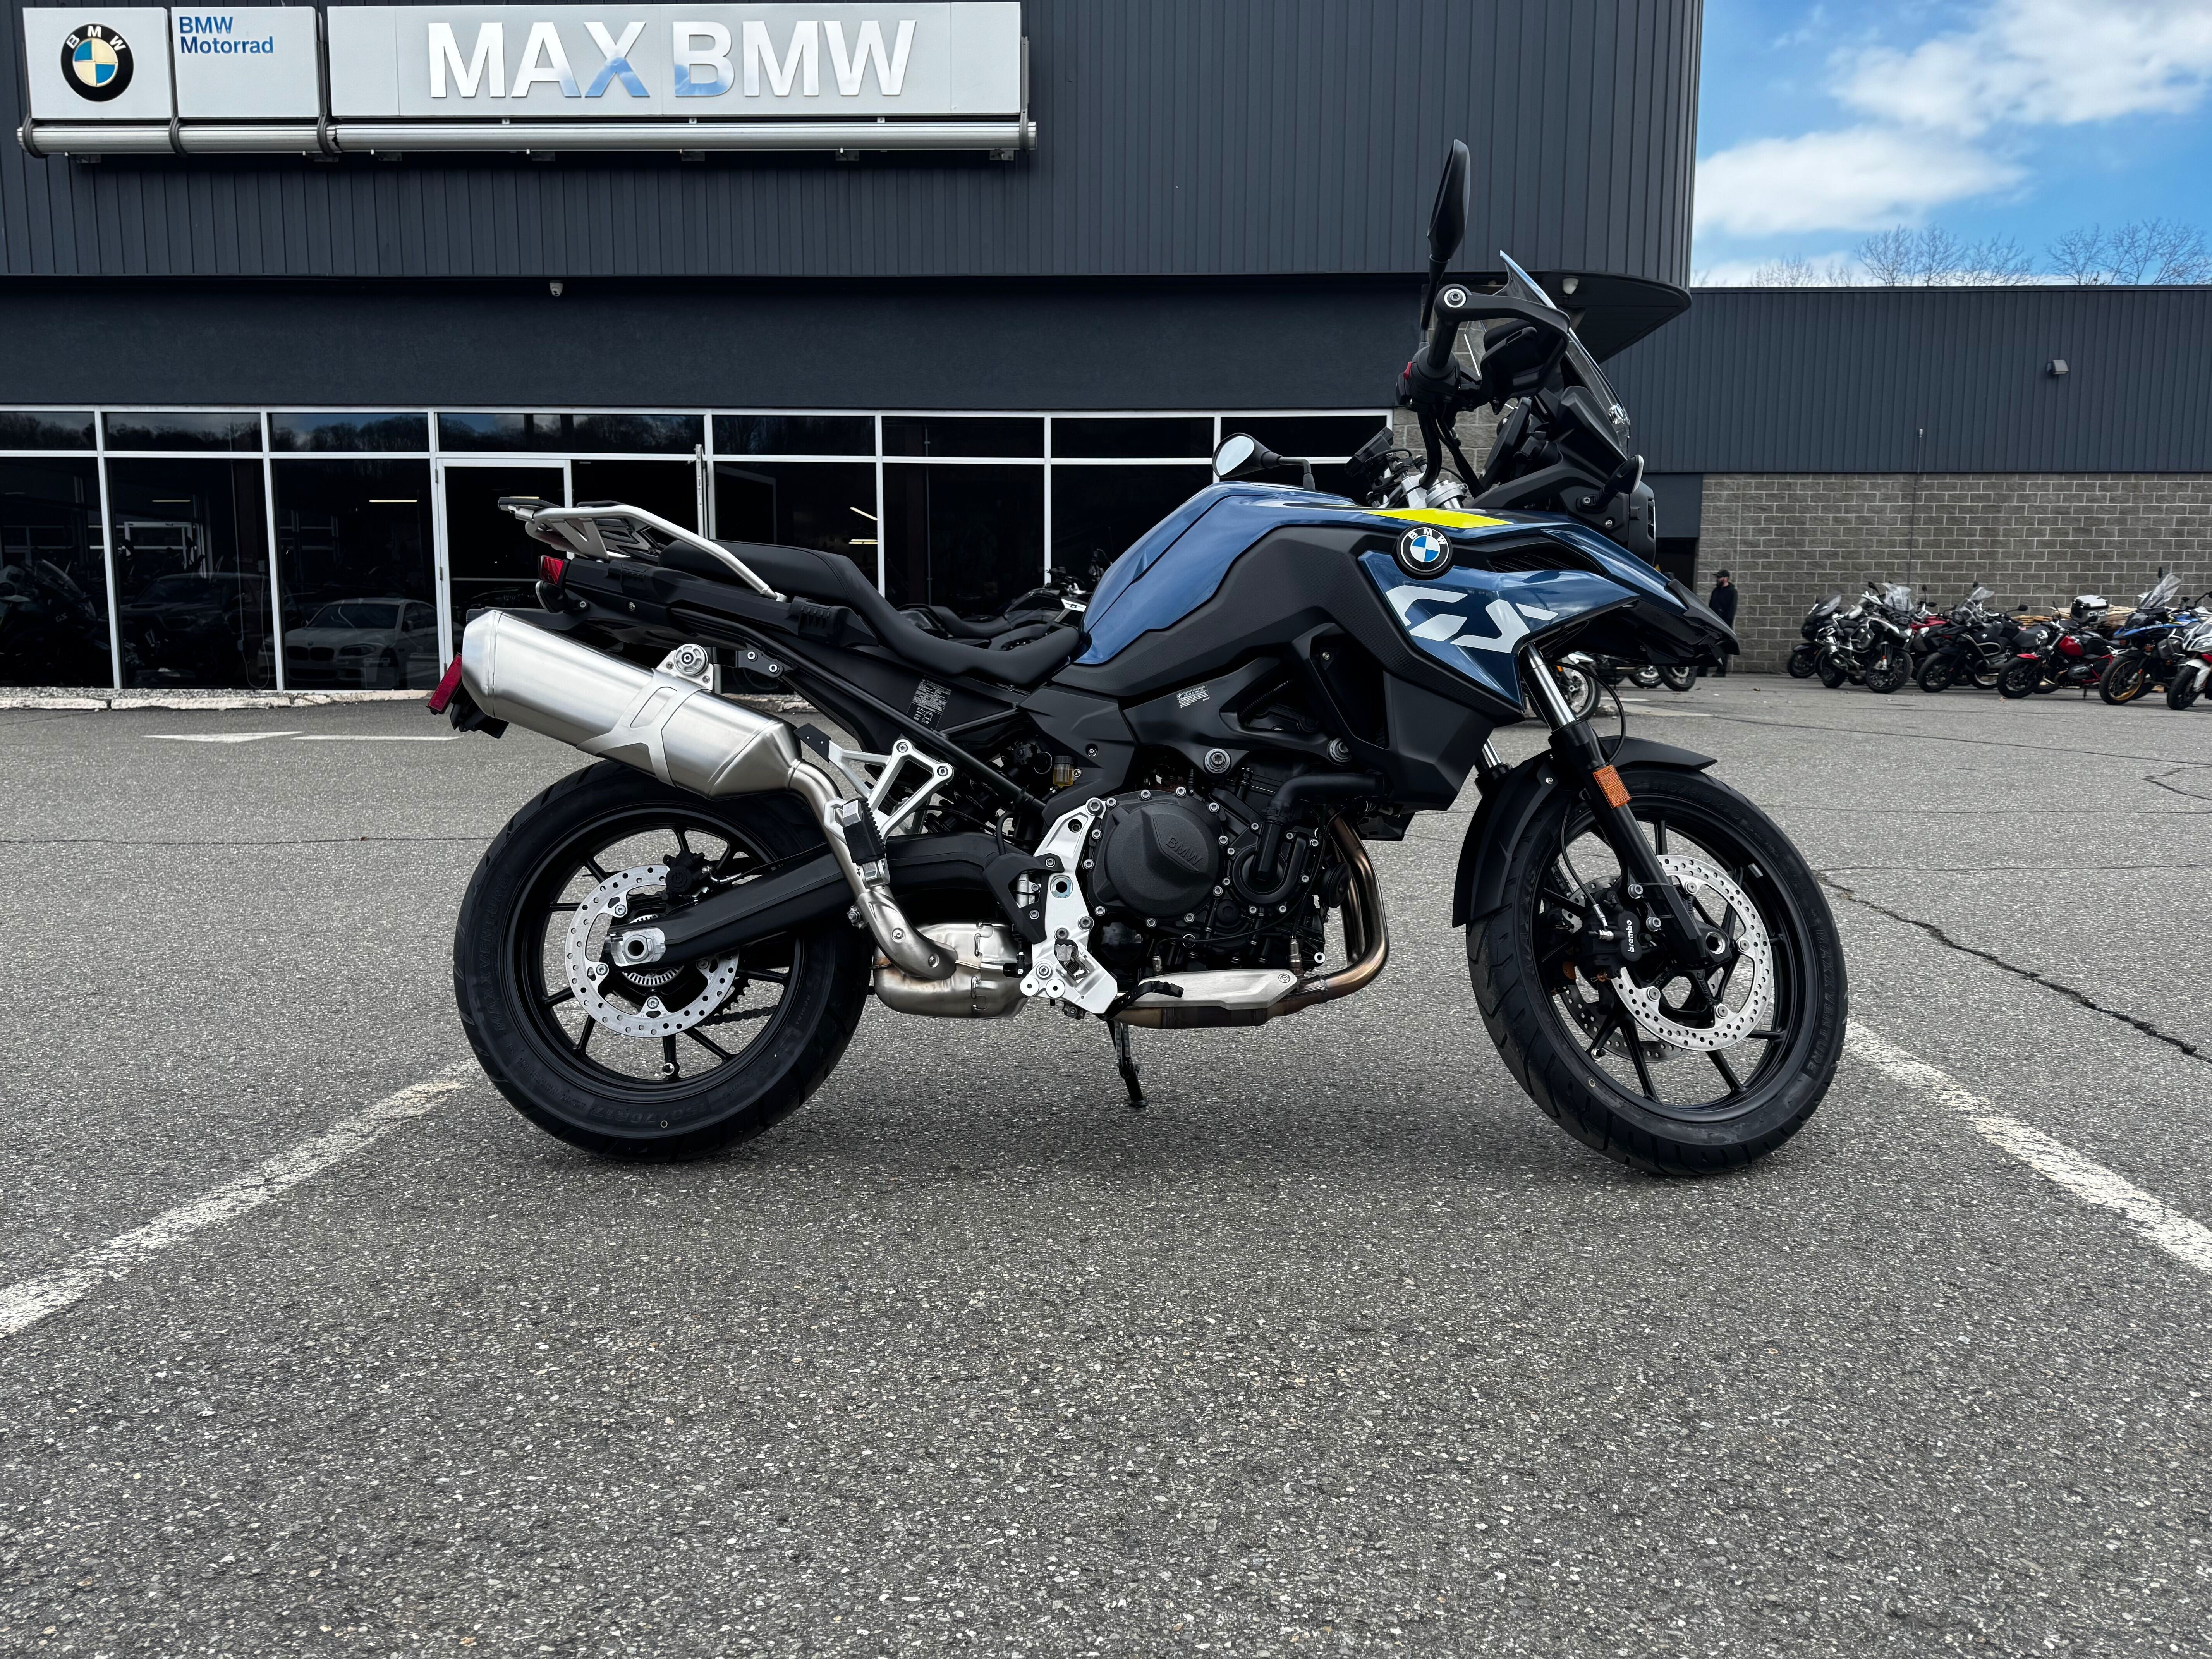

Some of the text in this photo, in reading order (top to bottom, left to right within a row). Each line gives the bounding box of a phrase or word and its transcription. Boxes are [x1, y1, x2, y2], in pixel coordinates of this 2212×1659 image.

[179, 16, 234, 34] BMW
[66, 26, 126, 52] BMW
[180, 36, 273, 54] Motorrad
[428, 19, 916, 98] MAX BMW
[1408, 528, 1447, 545] BMW
[1165, 837, 1203, 865] BMW
[1626, 920, 1635, 952] brembo
